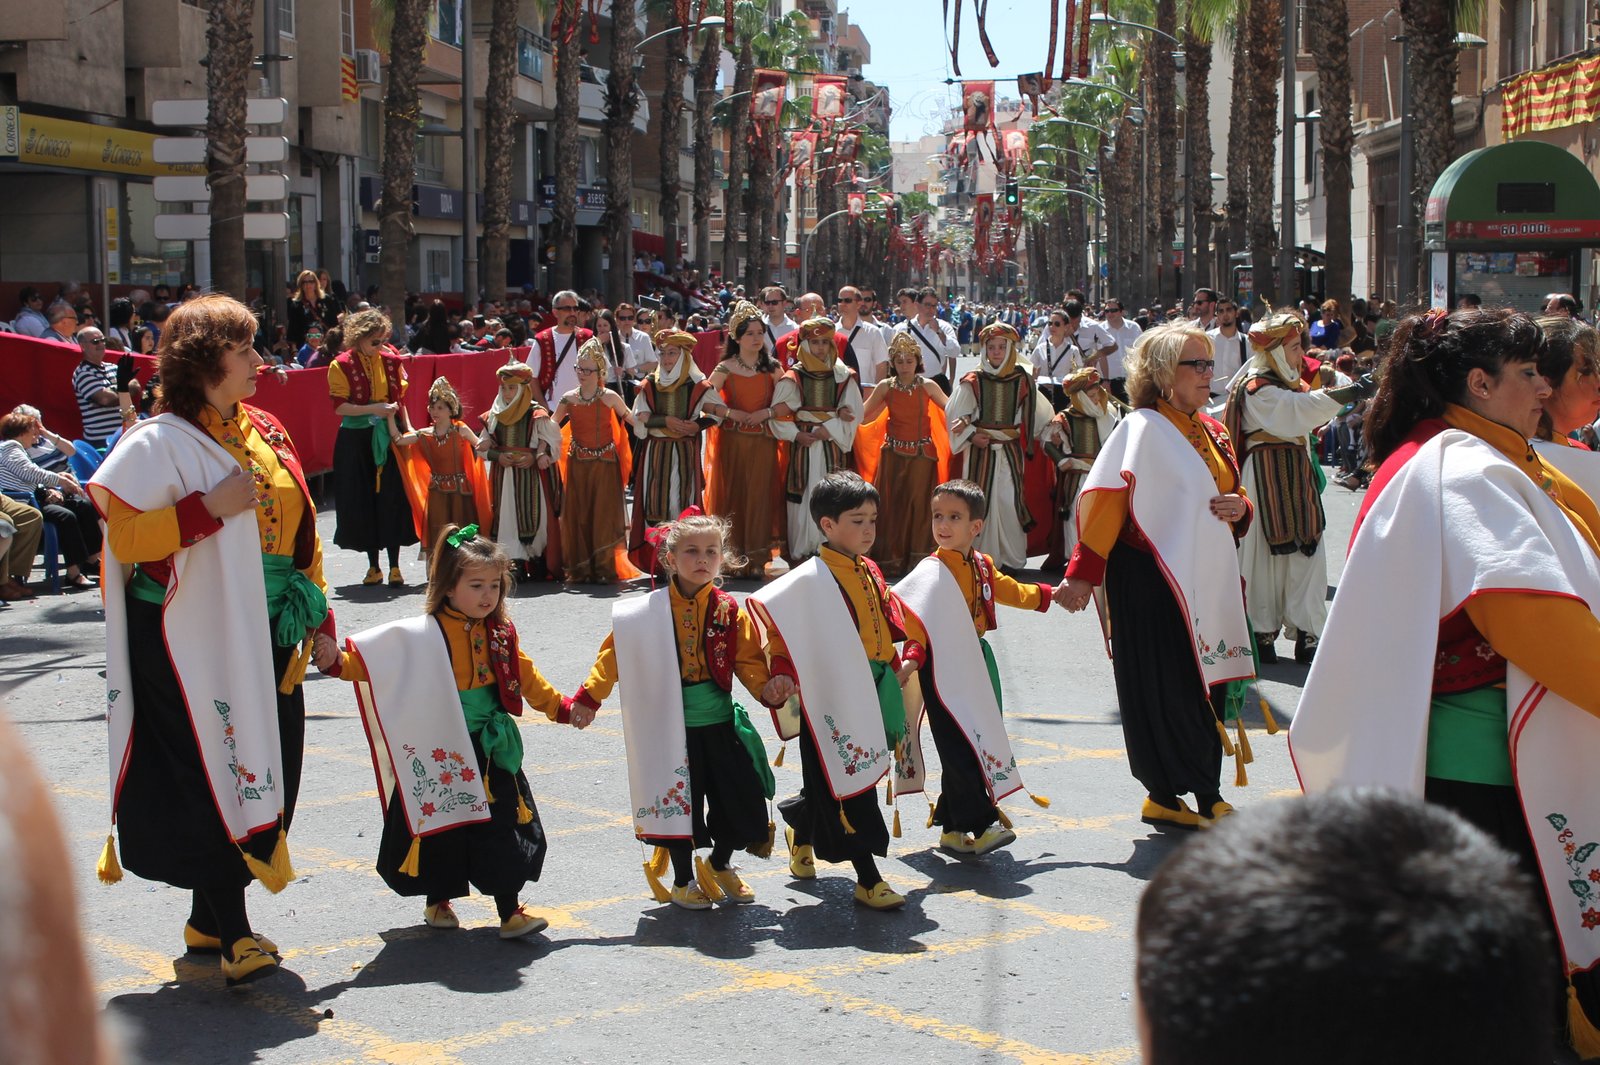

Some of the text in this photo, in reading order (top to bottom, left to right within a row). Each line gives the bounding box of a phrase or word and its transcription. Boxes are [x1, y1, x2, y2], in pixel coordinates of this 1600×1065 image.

[5, 107, 16, 153] CORREOS
[35, 134, 71, 158] CORREOS
[111, 144, 142, 166] CORREOS
